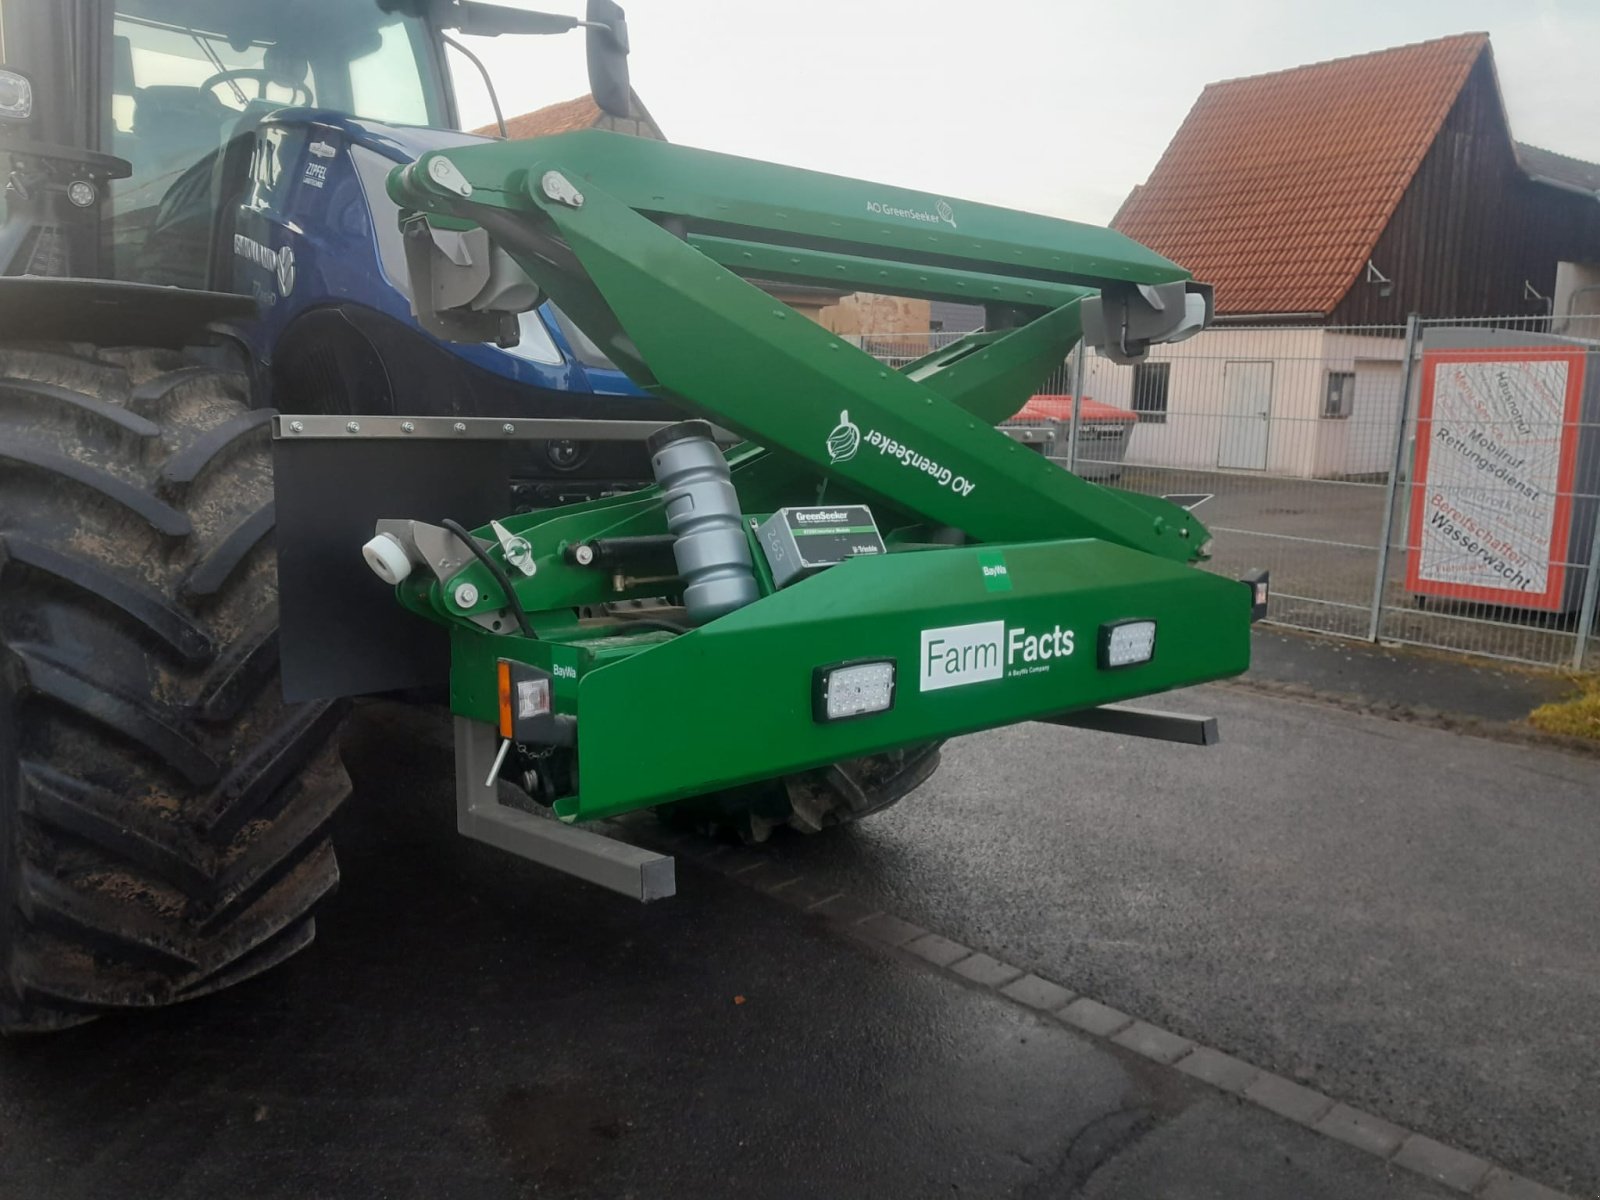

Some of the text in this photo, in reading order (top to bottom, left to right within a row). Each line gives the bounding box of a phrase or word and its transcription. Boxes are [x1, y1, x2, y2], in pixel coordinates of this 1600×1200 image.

[306, 163, 328, 180] ZIPFEL
[866, 200, 940, 223] AO GreenSeeker
[1496, 371, 1531, 436] Hausnotruf
[863, 429, 976, 497] AO GreenSeeker
[1436, 427, 1540, 502] Rettungsdienst
[1468, 428, 1526, 469] Mobilruf
[796, 511, 848, 521] GreenSeeker
[1431, 493, 1528, 568] Bereitschaften
[982, 565, 1007, 577] BayWa
[1431, 511, 1531, 590] Wasserwacht
[553, 664, 577, 678] BayWa
[928, 624, 1075, 677] Farm Facts
